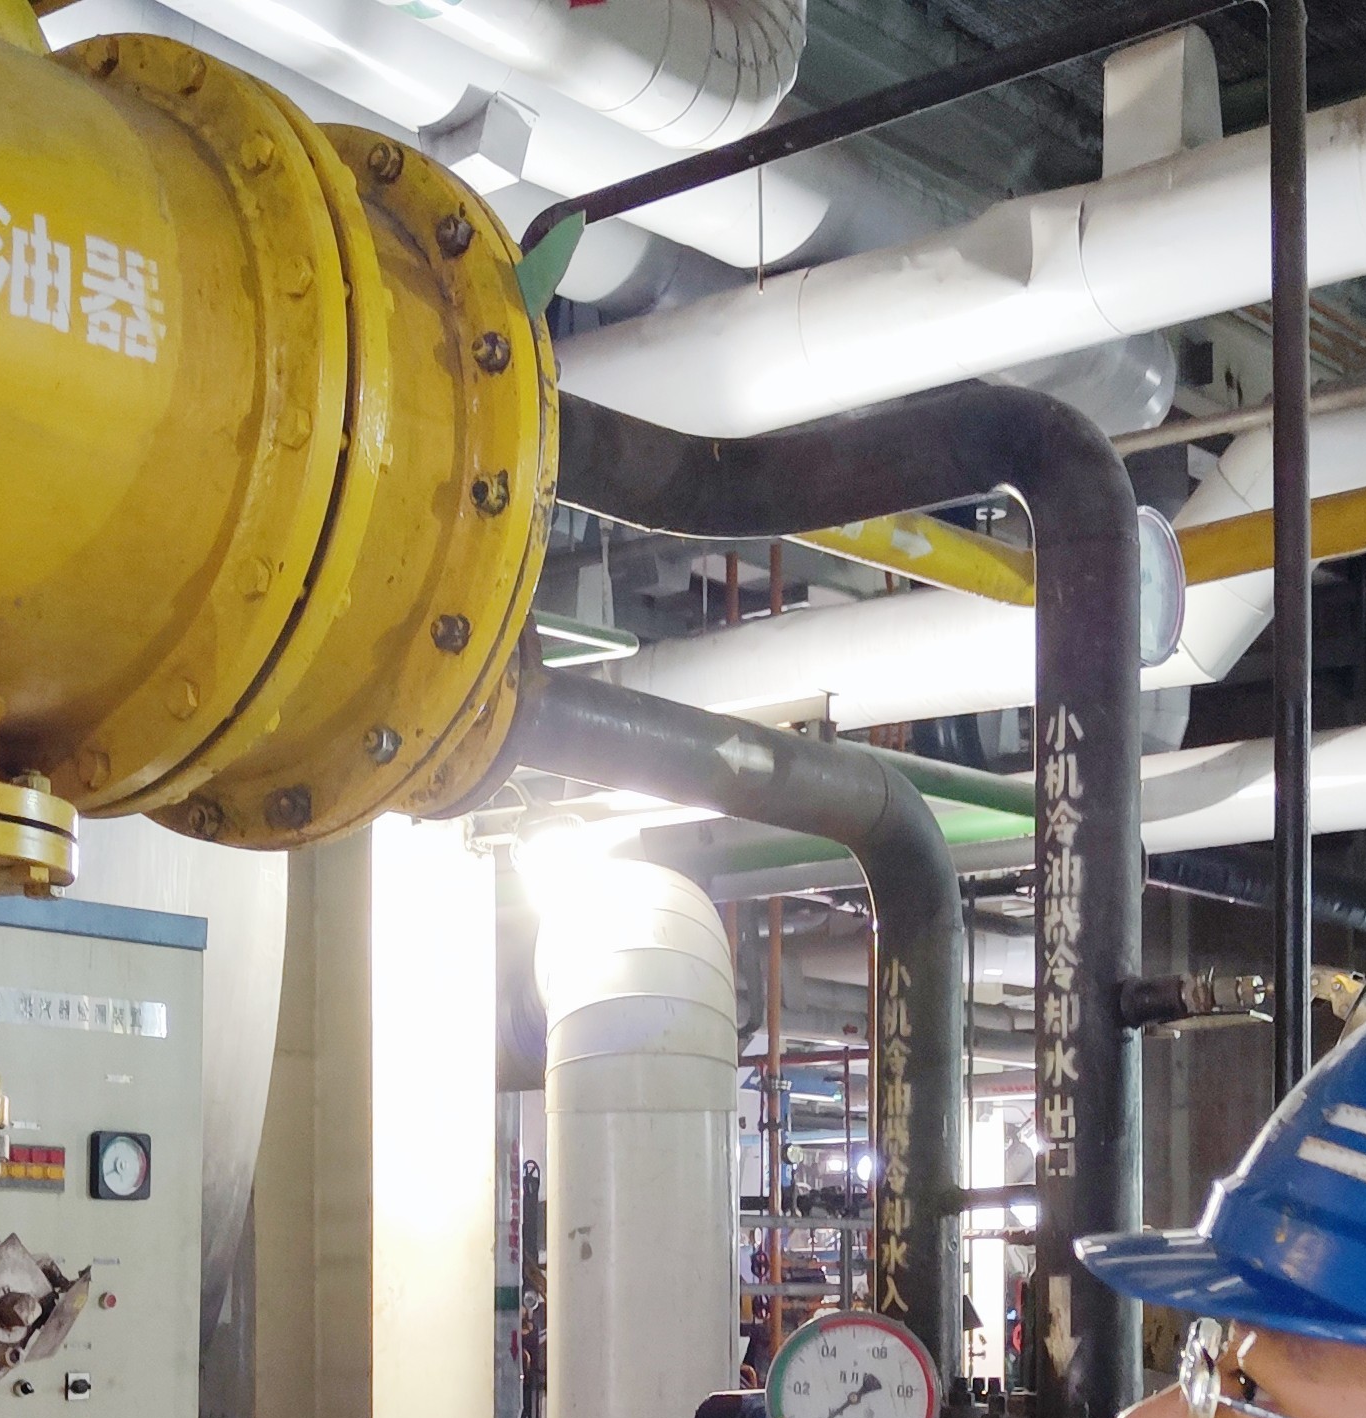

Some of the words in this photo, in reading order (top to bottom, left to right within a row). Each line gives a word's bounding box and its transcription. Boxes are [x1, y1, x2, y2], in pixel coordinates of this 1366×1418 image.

[1044, 704, 1085, 1178] 小机冷油器冷却水出口
